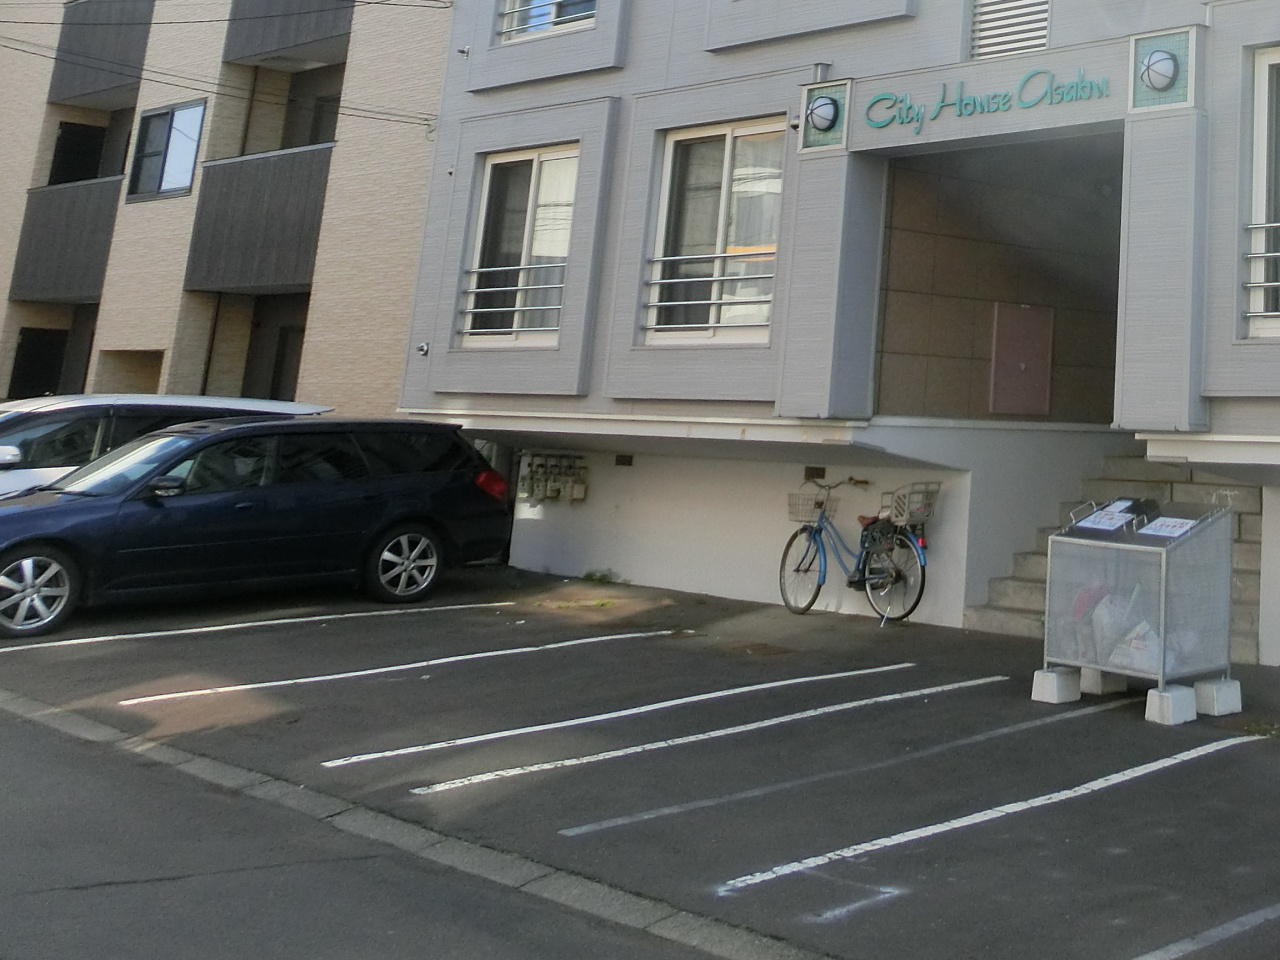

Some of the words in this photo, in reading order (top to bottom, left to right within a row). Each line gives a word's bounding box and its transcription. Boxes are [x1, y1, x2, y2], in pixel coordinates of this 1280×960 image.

[865, 92, 925, 135] City
[929, 81, 1012, 121] House
[1016, 67, 1111, 108] Asabu
